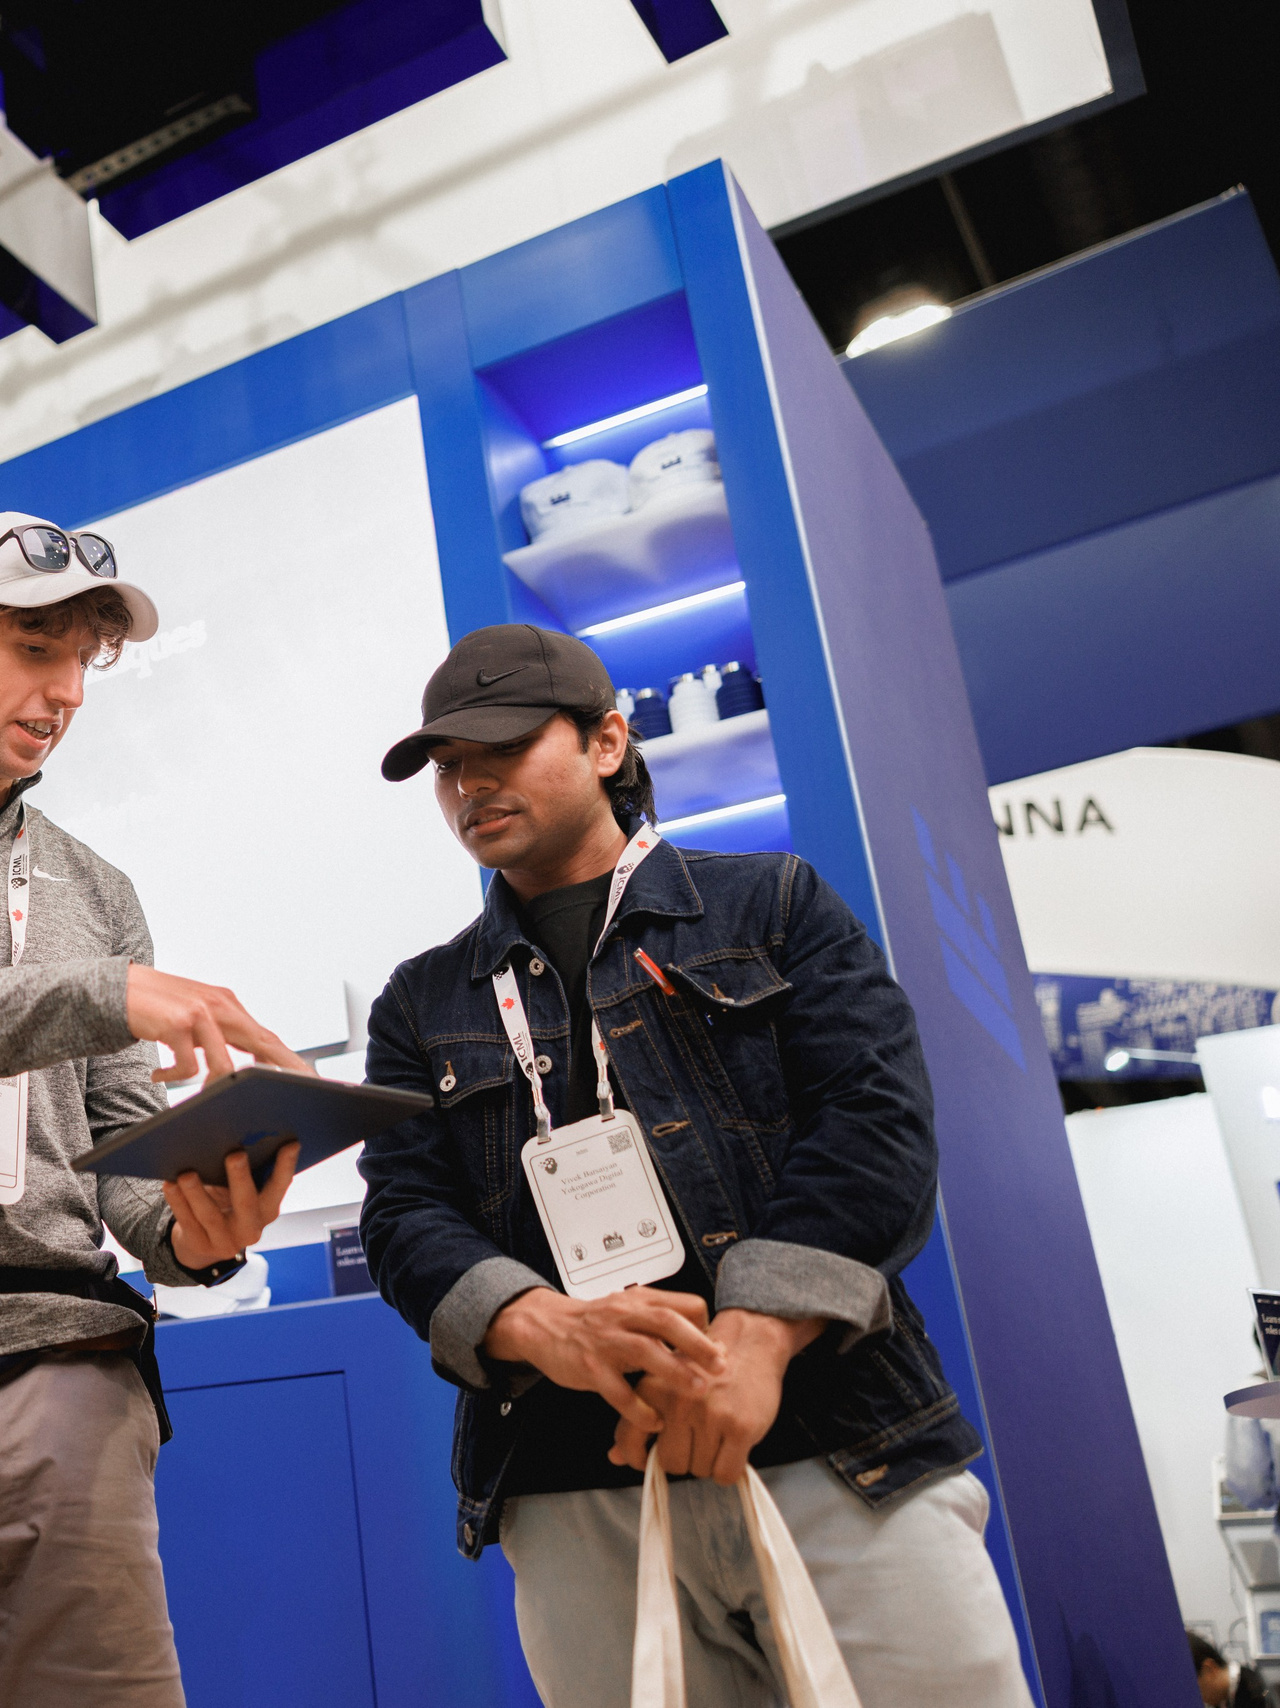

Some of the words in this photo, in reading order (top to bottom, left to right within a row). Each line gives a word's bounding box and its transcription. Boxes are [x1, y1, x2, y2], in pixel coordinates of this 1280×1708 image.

[12, 855, 22, 876] ICML
[612, 875, 627, 903] ICML
[510, 1032, 528, 1064] ICML
[560, 1174, 582, 1185] Vivek
[561, 1179, 599, 1195] Yokogawa
[598, 1169, 623, 1183] Digital
[574, 1182, 616, 1200] Corporation
